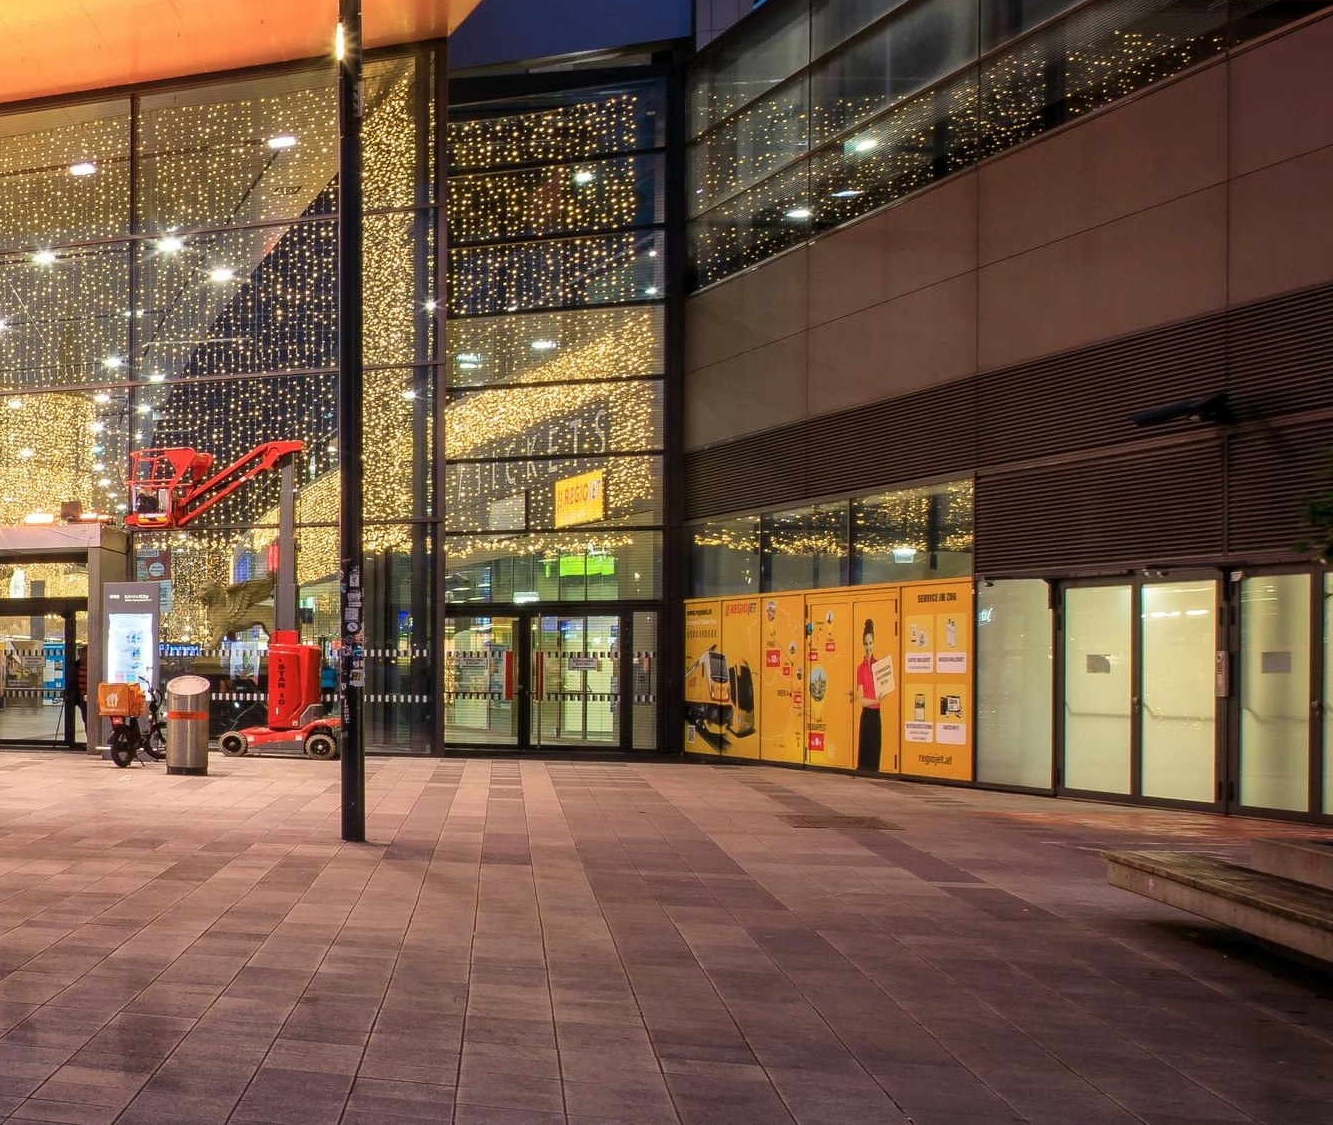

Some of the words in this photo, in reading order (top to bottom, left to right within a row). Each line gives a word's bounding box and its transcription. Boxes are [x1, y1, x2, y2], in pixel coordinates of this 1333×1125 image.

[917, 593, 938, 603] SERVICE
[946, 592, 957, 601] ZUG
[278, 664, 286, 689] STAR
[278, 693, 285, 705] 10
[918, 754, 953, 766] regiojet.at
